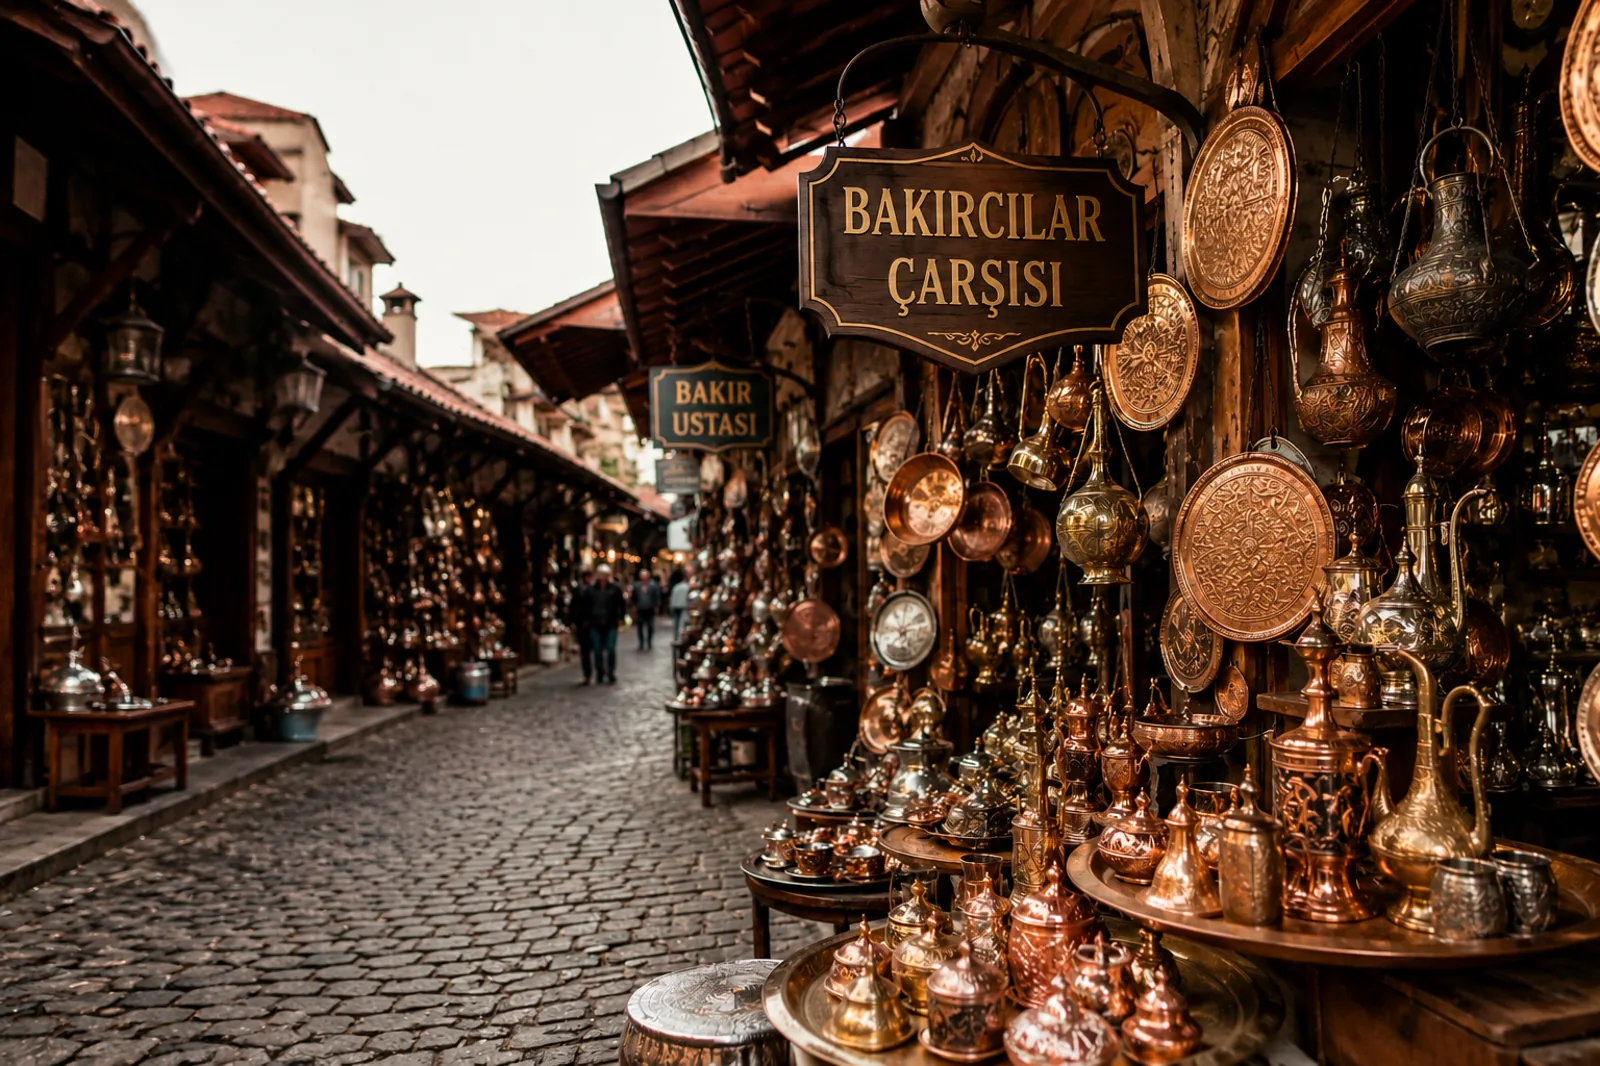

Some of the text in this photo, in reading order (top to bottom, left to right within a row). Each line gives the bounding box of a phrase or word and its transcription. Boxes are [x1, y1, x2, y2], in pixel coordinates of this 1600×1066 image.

[843, 186, 1106, 242] BAKIRCILAR
[888, 257, 1063, 319] ÇARŞISI
[675, 380, 751, 405] BAKIR
[672, 411, 757, 436] USTASI
